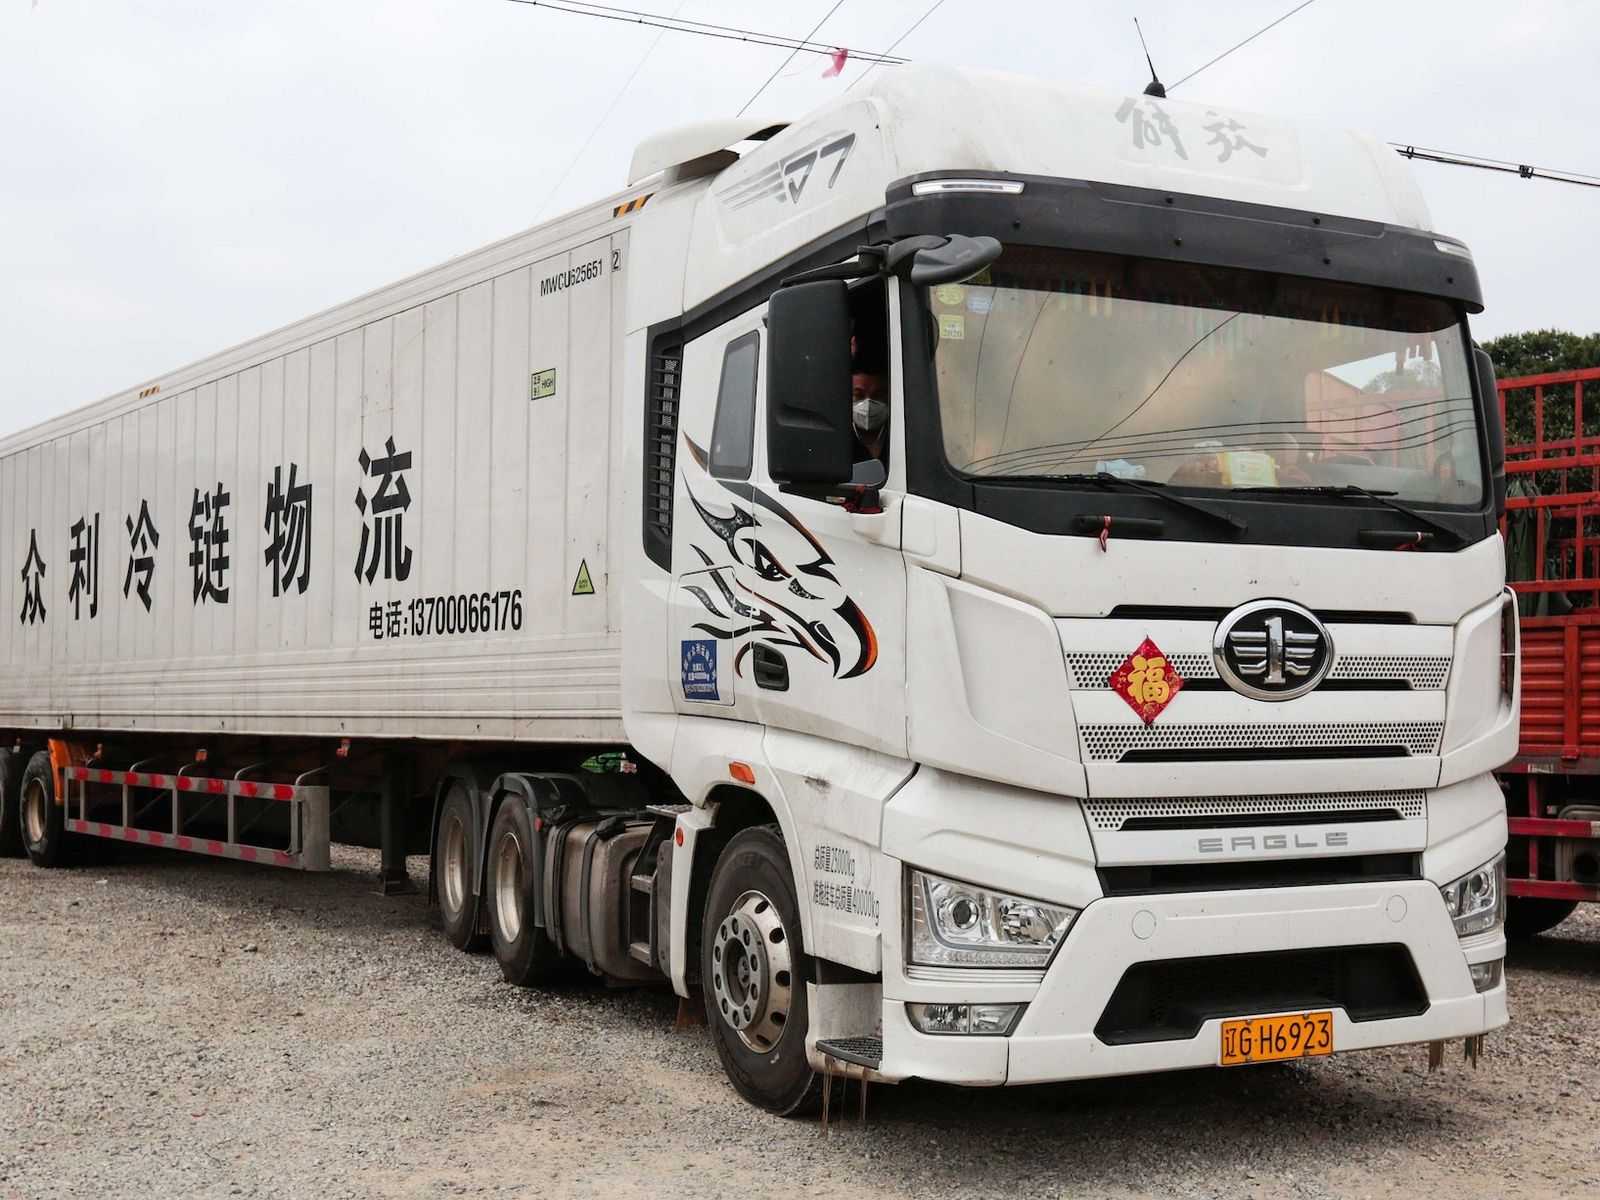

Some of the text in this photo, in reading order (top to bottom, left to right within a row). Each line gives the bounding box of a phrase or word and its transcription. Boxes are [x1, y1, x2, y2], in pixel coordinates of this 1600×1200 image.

[540, 251, 619, 297] MWCU625651 2
[20, 435, 413, 625] 众利冷链物流
[369, 589, 523, 640] 电话:13700066176
[1127, 654, 1170, 704] 福
[1198, 831, 1349, 853] EAGLE
